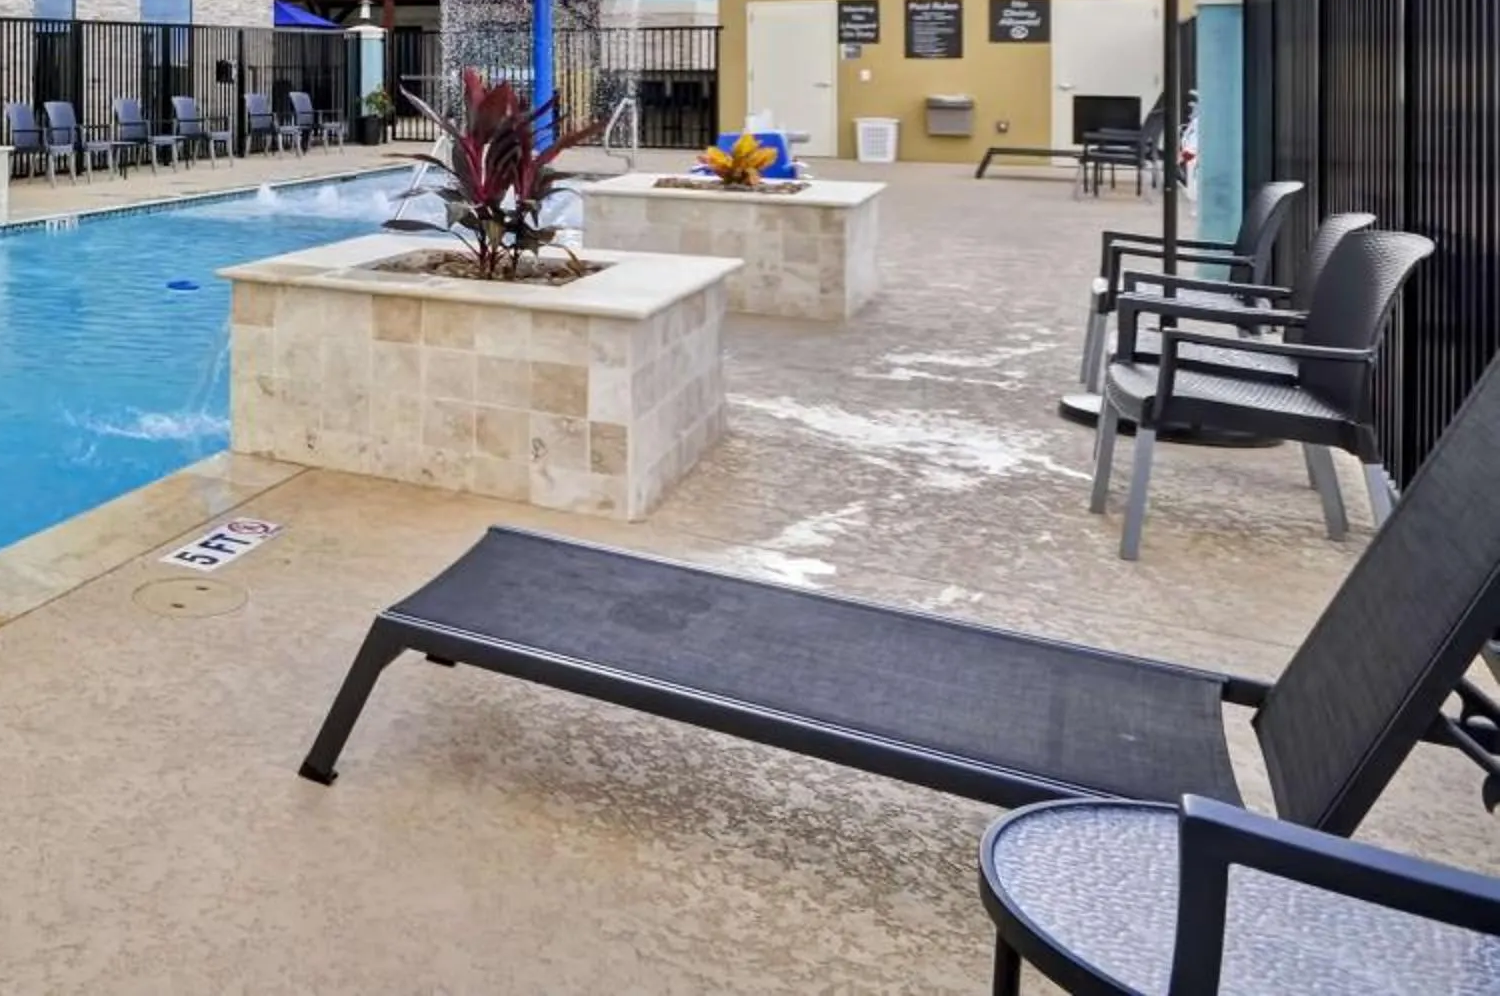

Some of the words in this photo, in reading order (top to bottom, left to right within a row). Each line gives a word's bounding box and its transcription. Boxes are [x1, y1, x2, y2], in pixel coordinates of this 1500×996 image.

[908, 2, 930, 11] Pool
[931, 2, 959, 11] Rules
[174, 551, 220, 565] 5
[198, 533, 252, 555] FT
